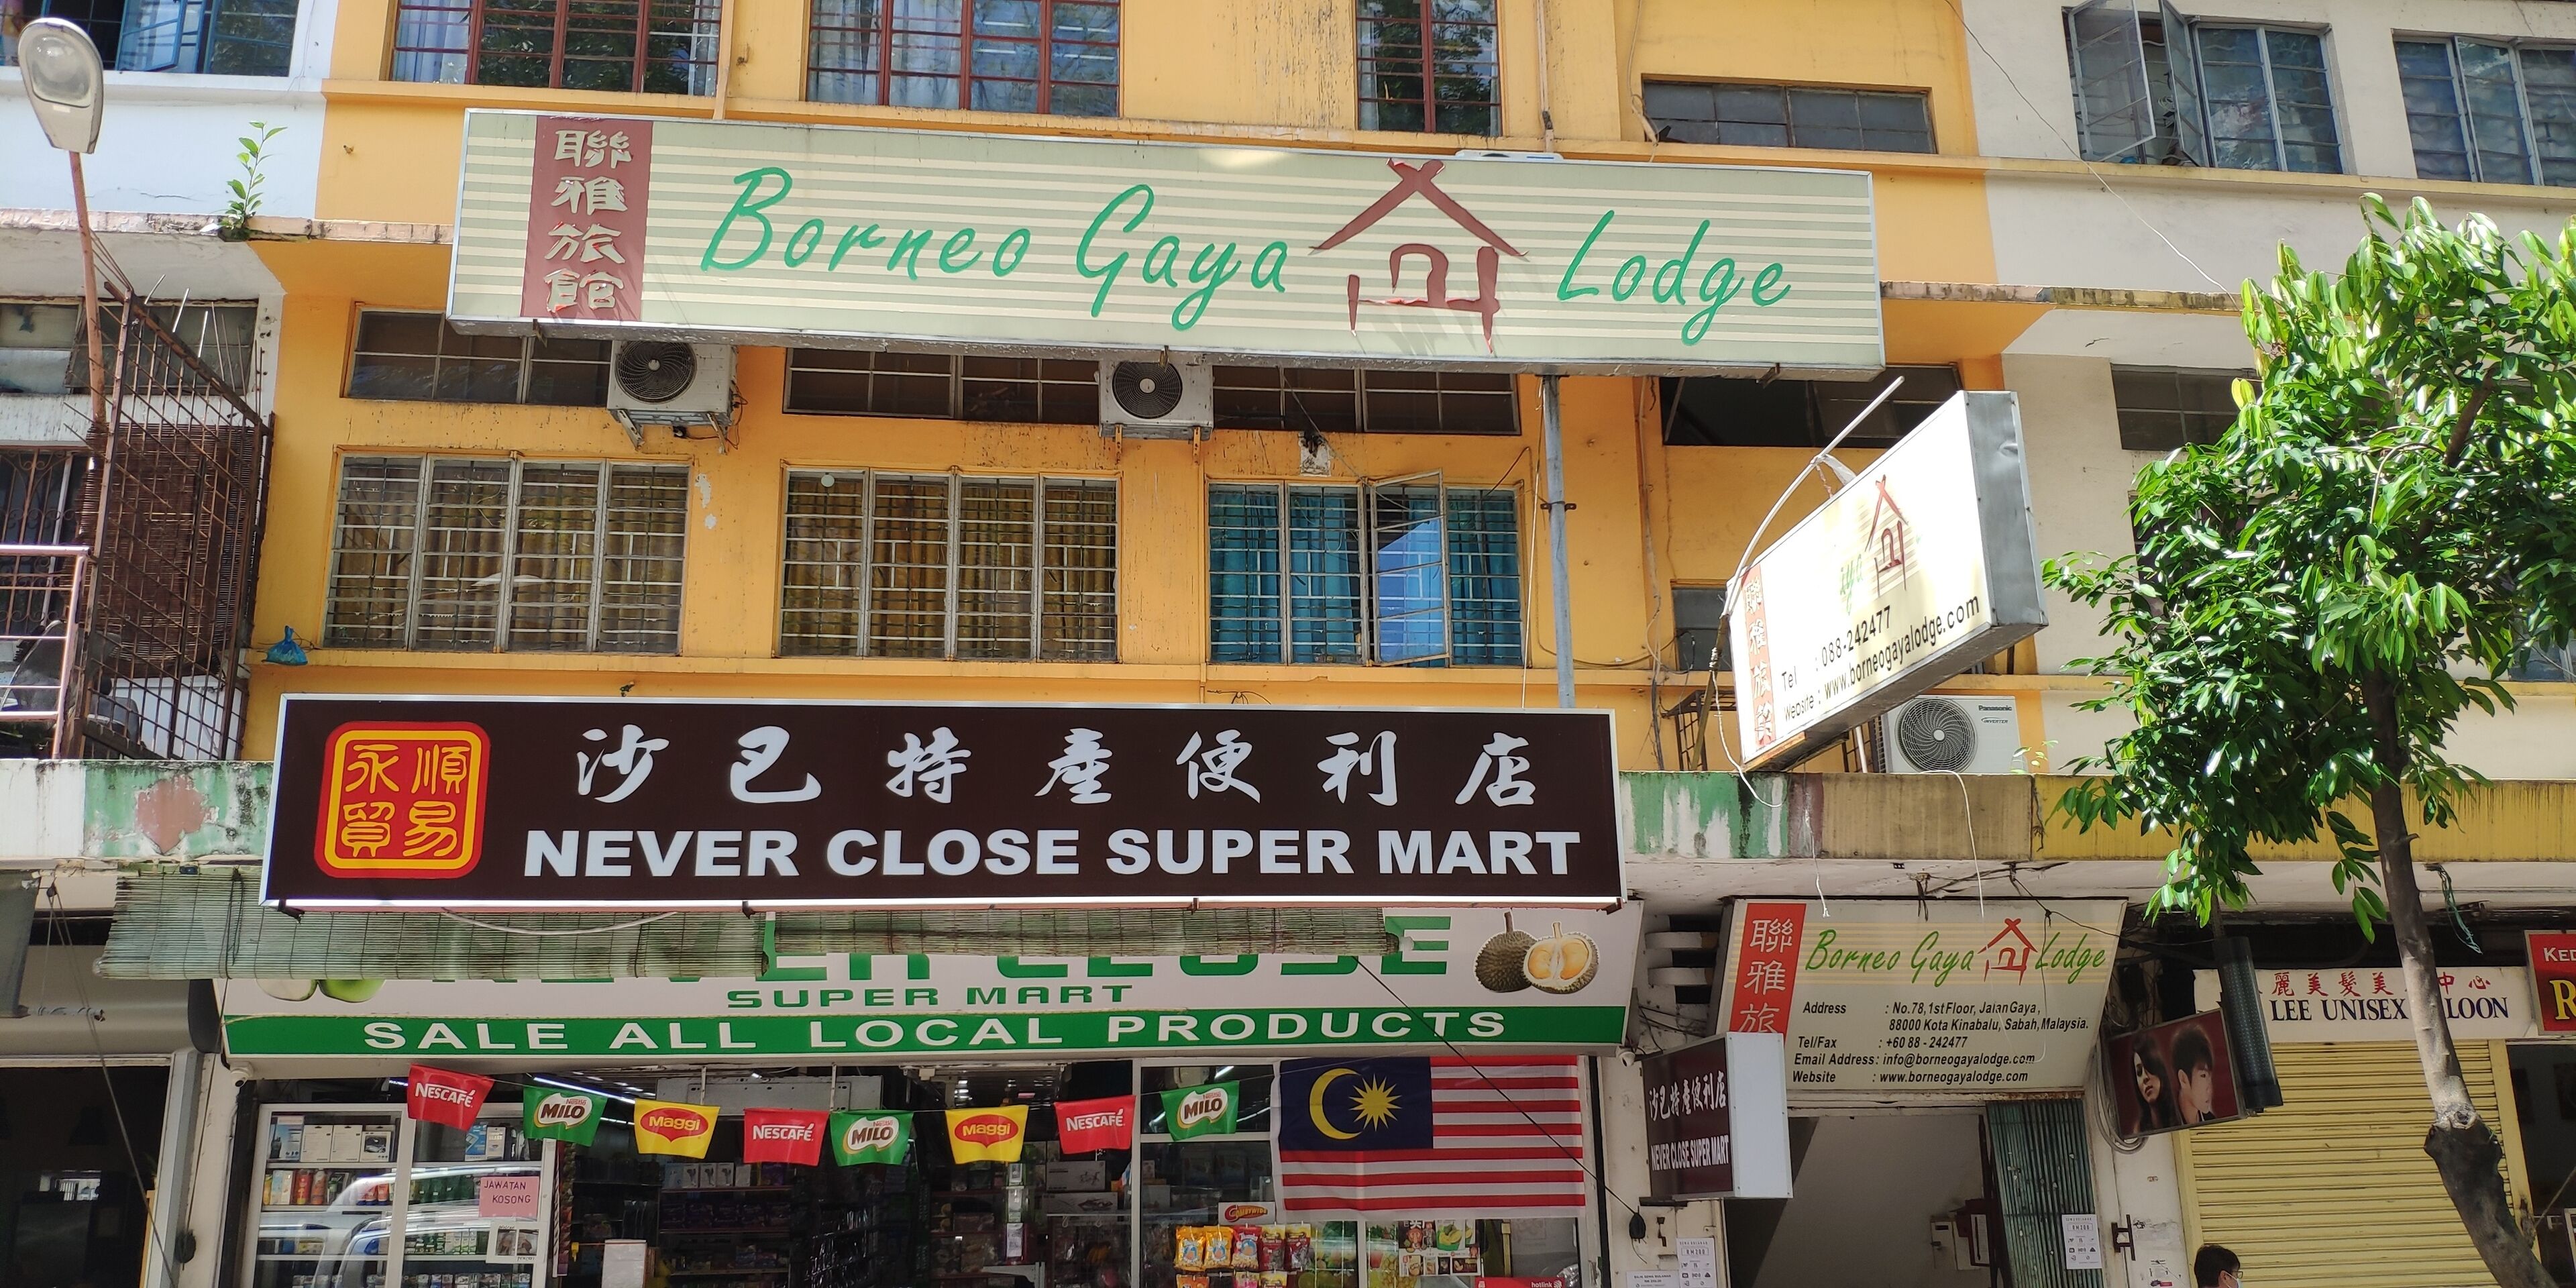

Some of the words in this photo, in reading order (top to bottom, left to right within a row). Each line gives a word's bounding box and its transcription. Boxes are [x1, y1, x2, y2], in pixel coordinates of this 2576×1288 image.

[544, 127, 633, 313] 聯雅旅館
[700, 166, 1031, 281] Borneo
[1075, 184, 1287, 331] Gaya
[1556, 209, 1792, 346] Lodge
[1822, 605, 1890, 667] 088-242477
[1825, 596, 1980, 700] www.borneogayalodge.com
[524, 828, 800, 877] NEVER
[826, 828, 1080, 877] CLOSE
[1106, 828, 1355, 875] SUPER
[1378, 829, 1580, 875] MART
[1805, 929, 1901, 972] Borneo
[1911, 930, 1974, 987] Gaya
[2035, 932, 2106, 984] Lodge
[727, 987, 938, 1009] SUPER
[967, 984, 1132, 1005] MART
[1803, 1002, 1847, 1014] Address
[2270, 1000, 2312, 1021] LEE
[2322, 998, 2409, 1020] UNISEX
[2443, 997, 2509, 1019] LOON
[363, 1020, 569, 1050] SALE
[608, 1020, 757, 1049] ALL
[809, 1016, 1063, 1049] LOCAL
[1107, 1012, 1505, 1042] PRODUCTS
[1889, 1019, 1921, 1030] 88000
[1923, 1018, 1947, 1030] Kota
[1951, 1018, 2001, 1032] Kinabalu,
[2004, 1018, 2039, 1031] Sabah,
[2041, 1017, 2088, 1032] Malaysia.
[1798, 1036, 1837, 1048] Tel/Fax
[1886, 1036, 1905, 1048] +60
[1908, 1036, 1921, 1048] 88
[1929, 1036, 1968, 1048] 242477
[1794, 1053, 1825, 1065] Email
[1882, 1053, 2035, 1068] info@borneogayalodge.com
[1792, 1071, 1836, 1083] Website
[1880, 1070, 2029, 1085] www.borneogayalodge.com
[415, 1082, 476, 1108] NESCAFÉ
[541, 1103, 586, 1119] MILO
[1184, 1097, 1224, 1120] MILO
[649, 1116, 701, 1131] Maggi
[962, 1122, 1011, 1136] Maggi
[1065, 1109, 1126, 1132] NESCAFÉ
[752, 1124, 814, 1141] NESCAFÉ
[851, 1126, 893, 1145] MILO
[1651, 1143, 1671, 1171] NEVER
[1670, 1140, 1690, 1170] CLOSE
[1690, 1138, 1711, 1168] SUPER
[1711, 1134, 1729, 1165] MART
[484, 1180, 527, 1190] JAWATAN
[492, 1195, 531, 1204] KOSONG
